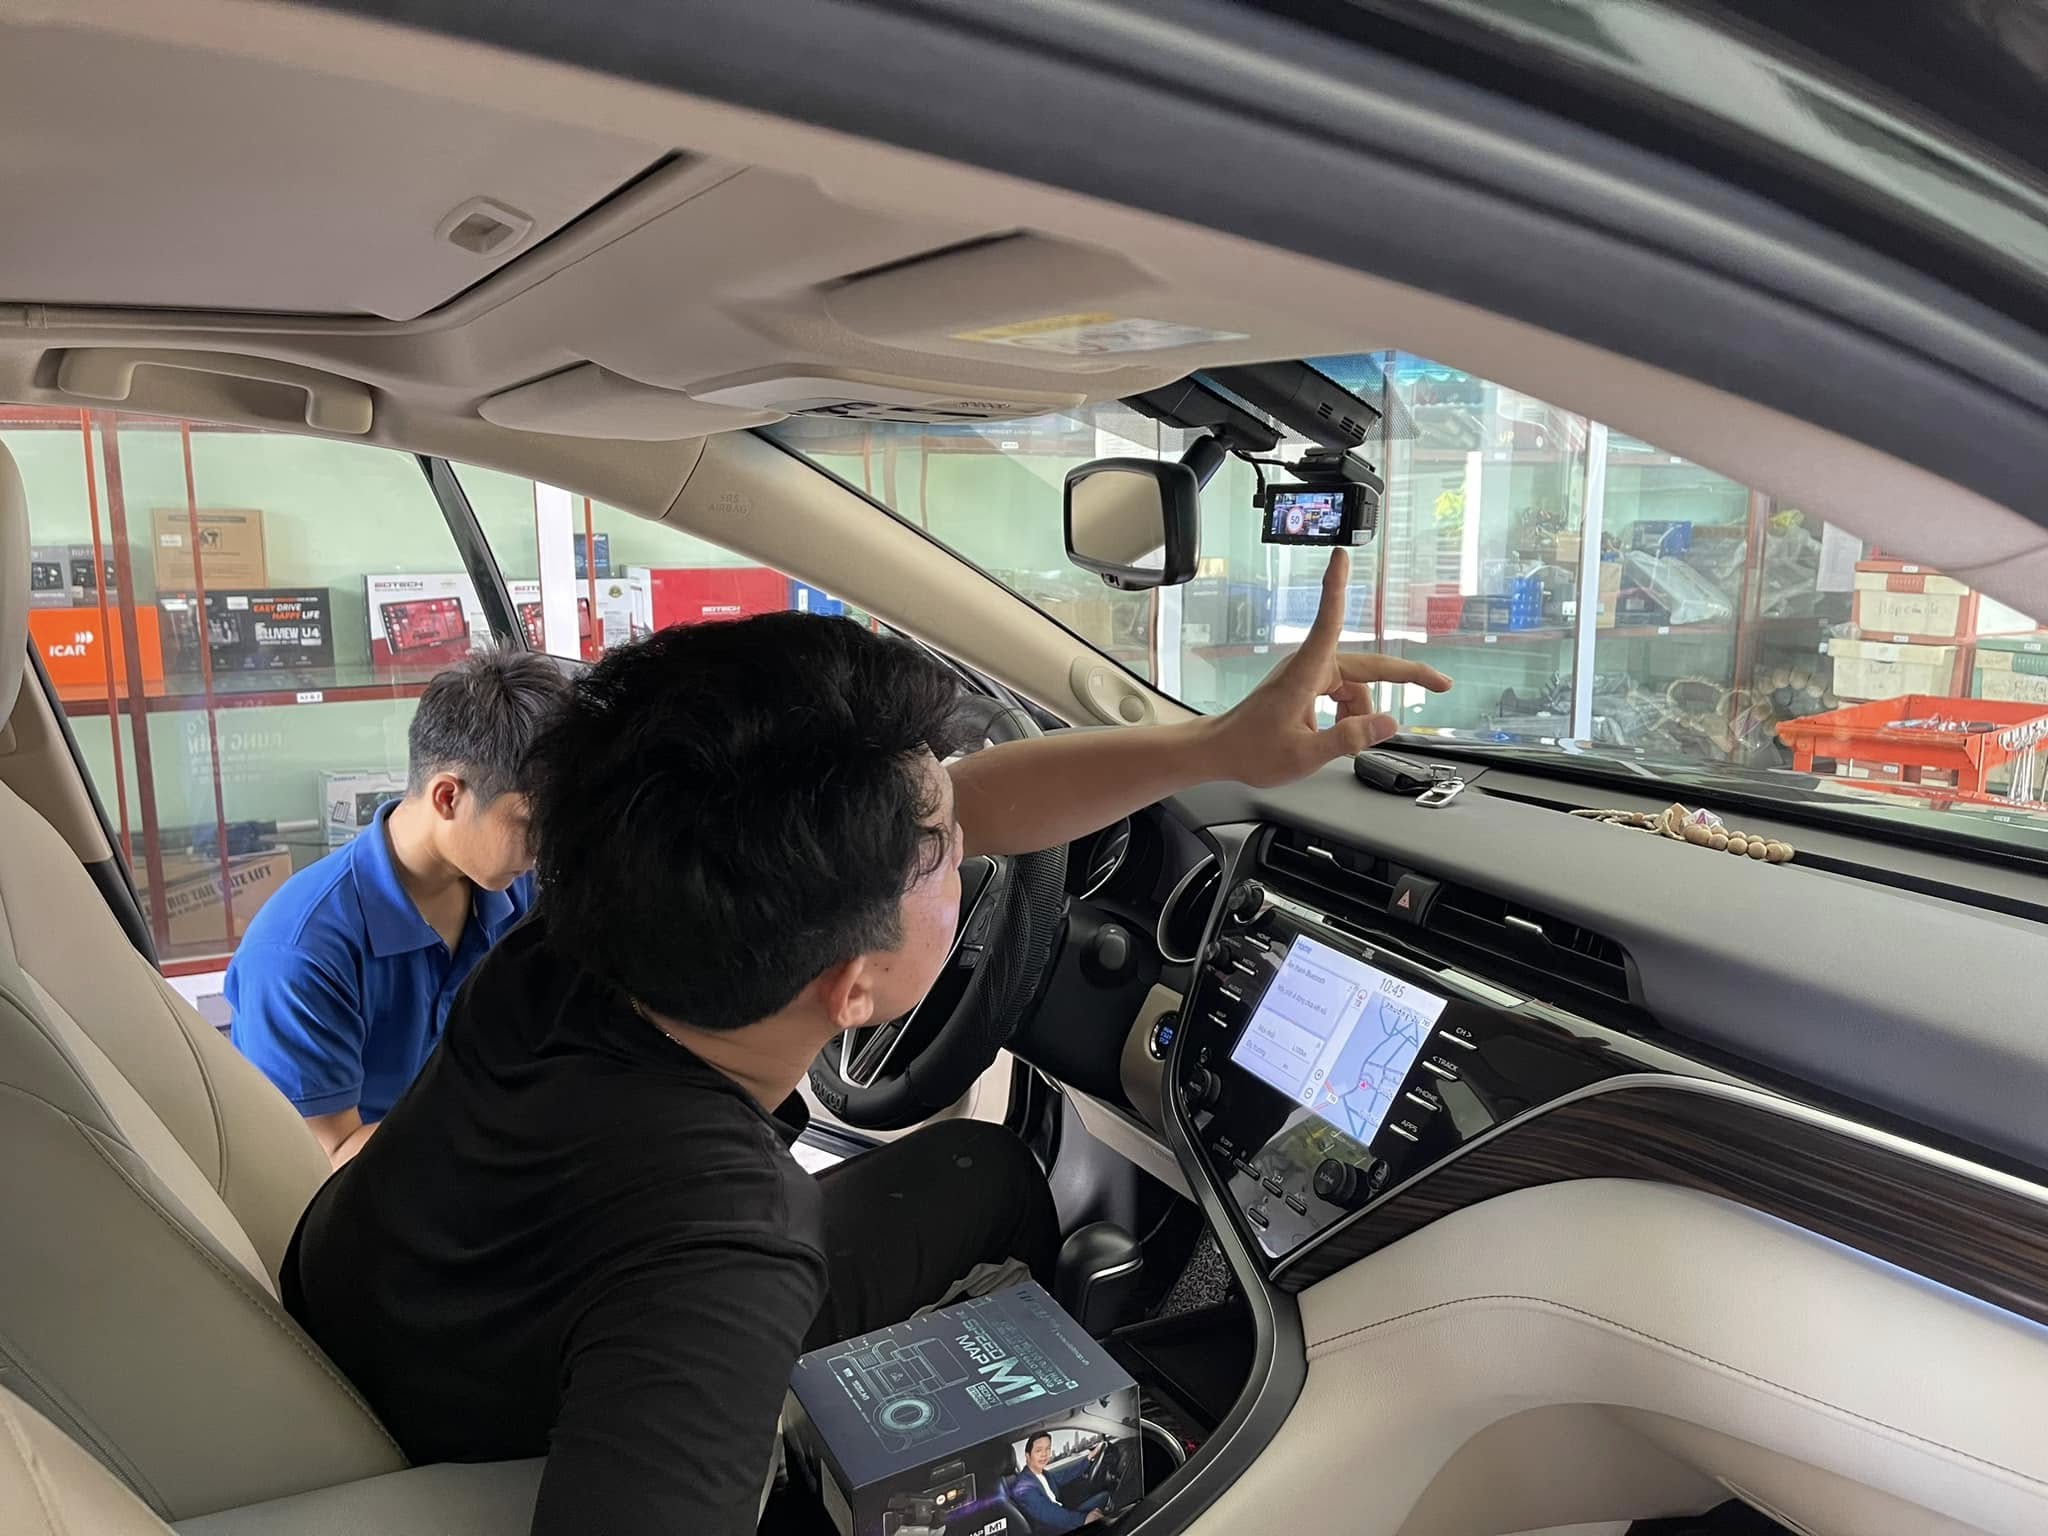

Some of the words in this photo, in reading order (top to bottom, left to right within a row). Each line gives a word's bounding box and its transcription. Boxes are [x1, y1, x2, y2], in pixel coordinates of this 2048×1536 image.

[276, 603, 301, 612] DRIVE
[301, 610, 320, 620] LIFE
[49, 644, 87, 657] ICAR
[1379, 977, 1406, 998] 10:45
[1415, 1086, 1438, 1101] PHONE
[1400, 1119, 1418, 1133] APPS
[955, 1334, 990, 1365] MAP
[978, 1356, 1047, 1406] M1
[977, 1384, 997, 1404] SONY
